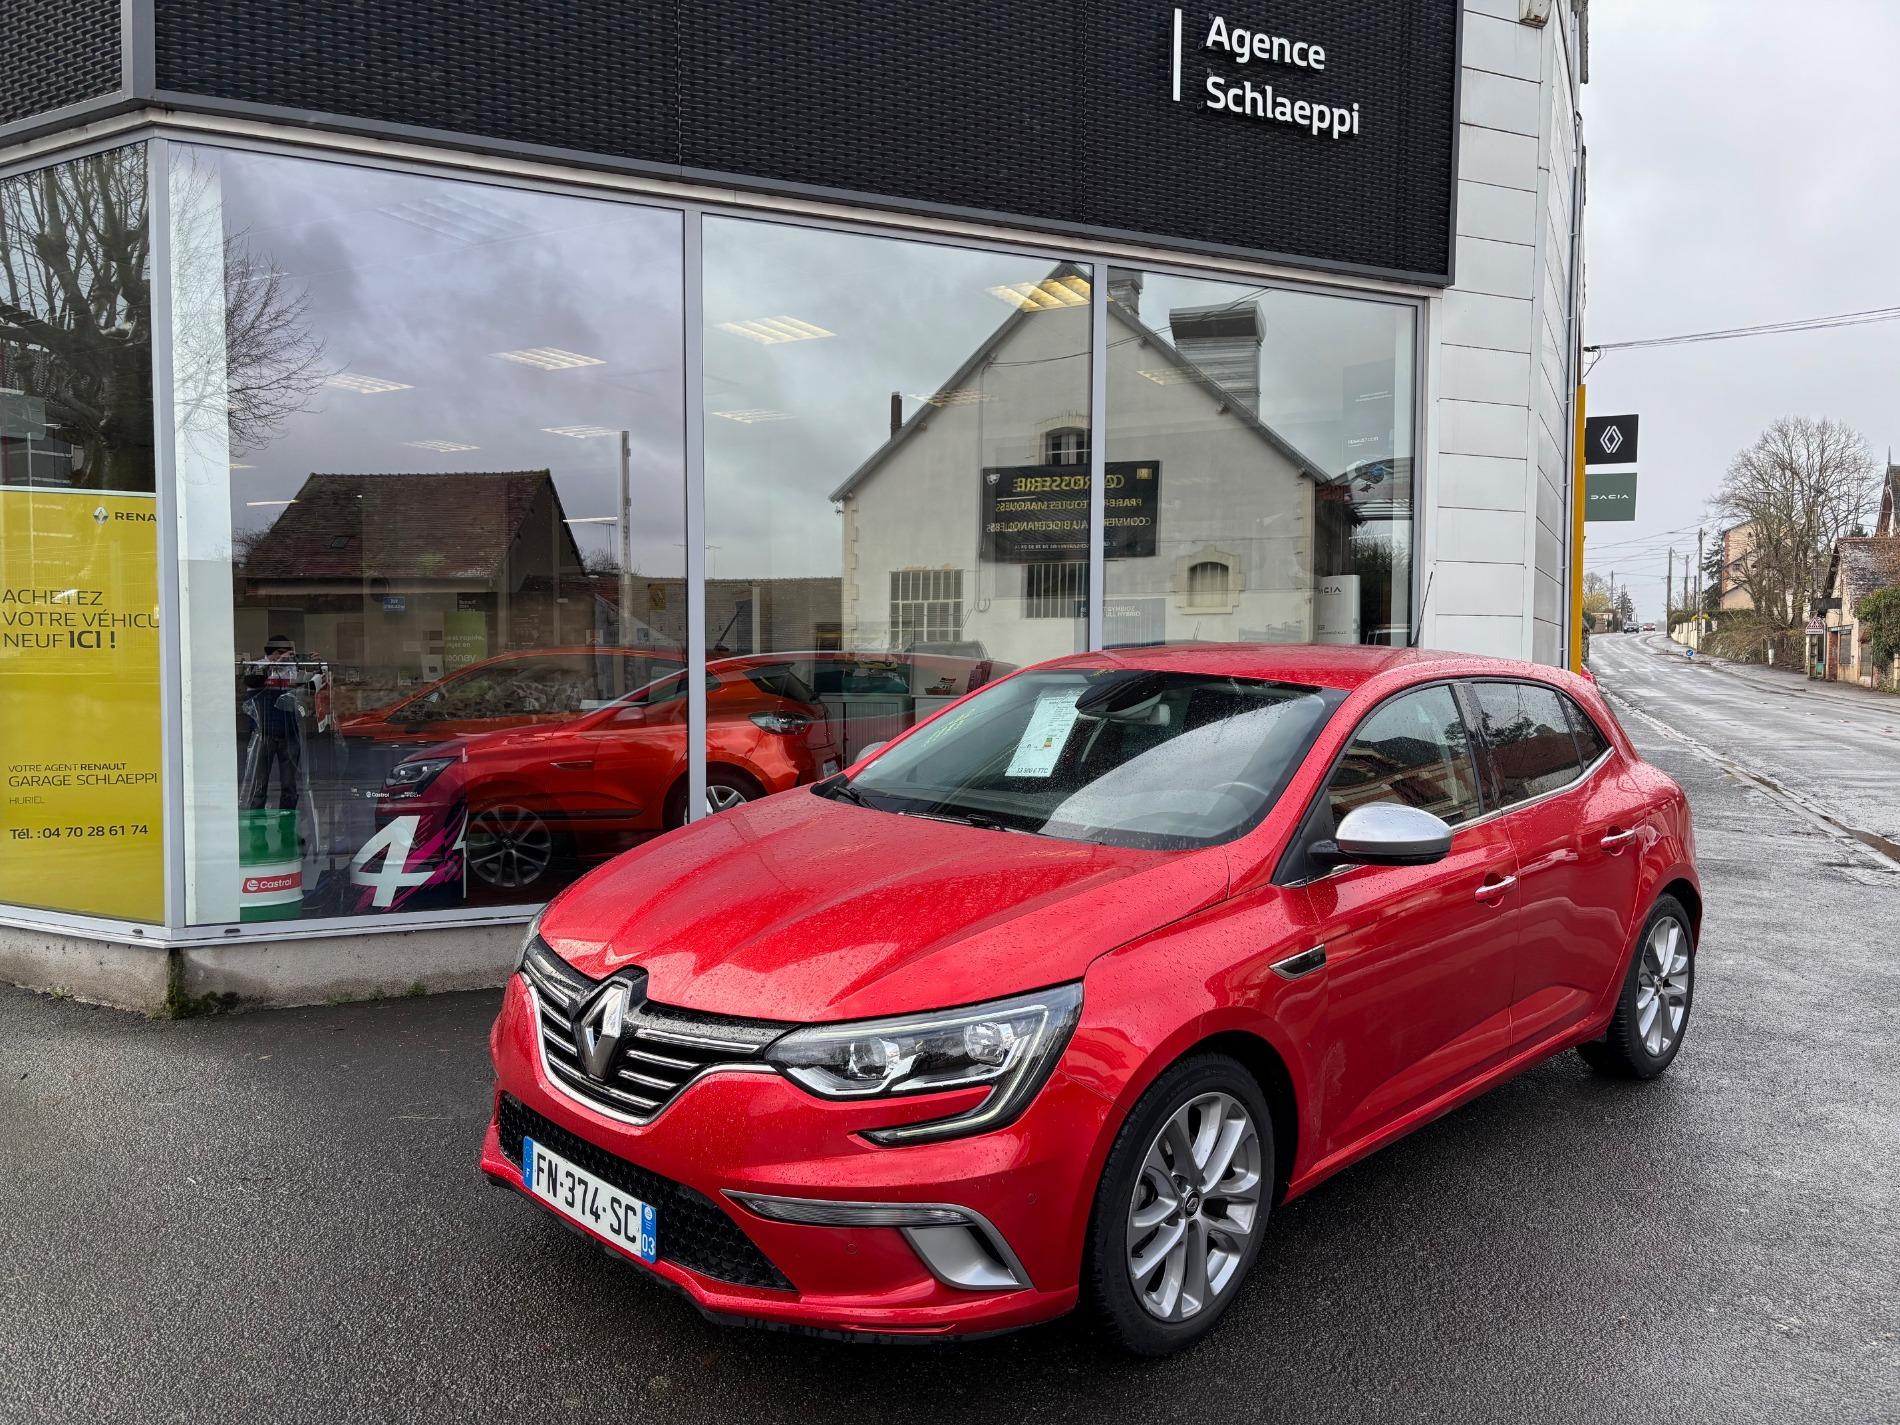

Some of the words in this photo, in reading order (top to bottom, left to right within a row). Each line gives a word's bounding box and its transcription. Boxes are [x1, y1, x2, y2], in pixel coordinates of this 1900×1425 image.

[1205, 16, 1326, 70] Agence
[1205, 76, 1360, 139] Schlaeppi
[2, 589, 104, 606] ACHETEZ
[2, 611, 77, 627] VOTRE
[4, 633, 65, 648] NEUF
[69, 630, 101, 649] ICI
[110, 630, 116, 649] !
[8, 764, 42, 773] VOTRE
[44, 763, 78, 772] AGENT
[80, 762, 127, 771] RENAULT
[8, 774, 73, 787] GARAGE
[76, 772, 158, 786] SCHLAEPPI
[9, 796, 46, 805] HURIEL
[9, 827, 33, 840] Tél.
[65, 826, 83, 838] 70
[87, 825, 105, 837] 28
[109, 825, 125, 836] 61
[131, 824, 148, 835] 74
[260, 877, 292, 889] Castrol
[642, 1232, 656, 1256] 03
